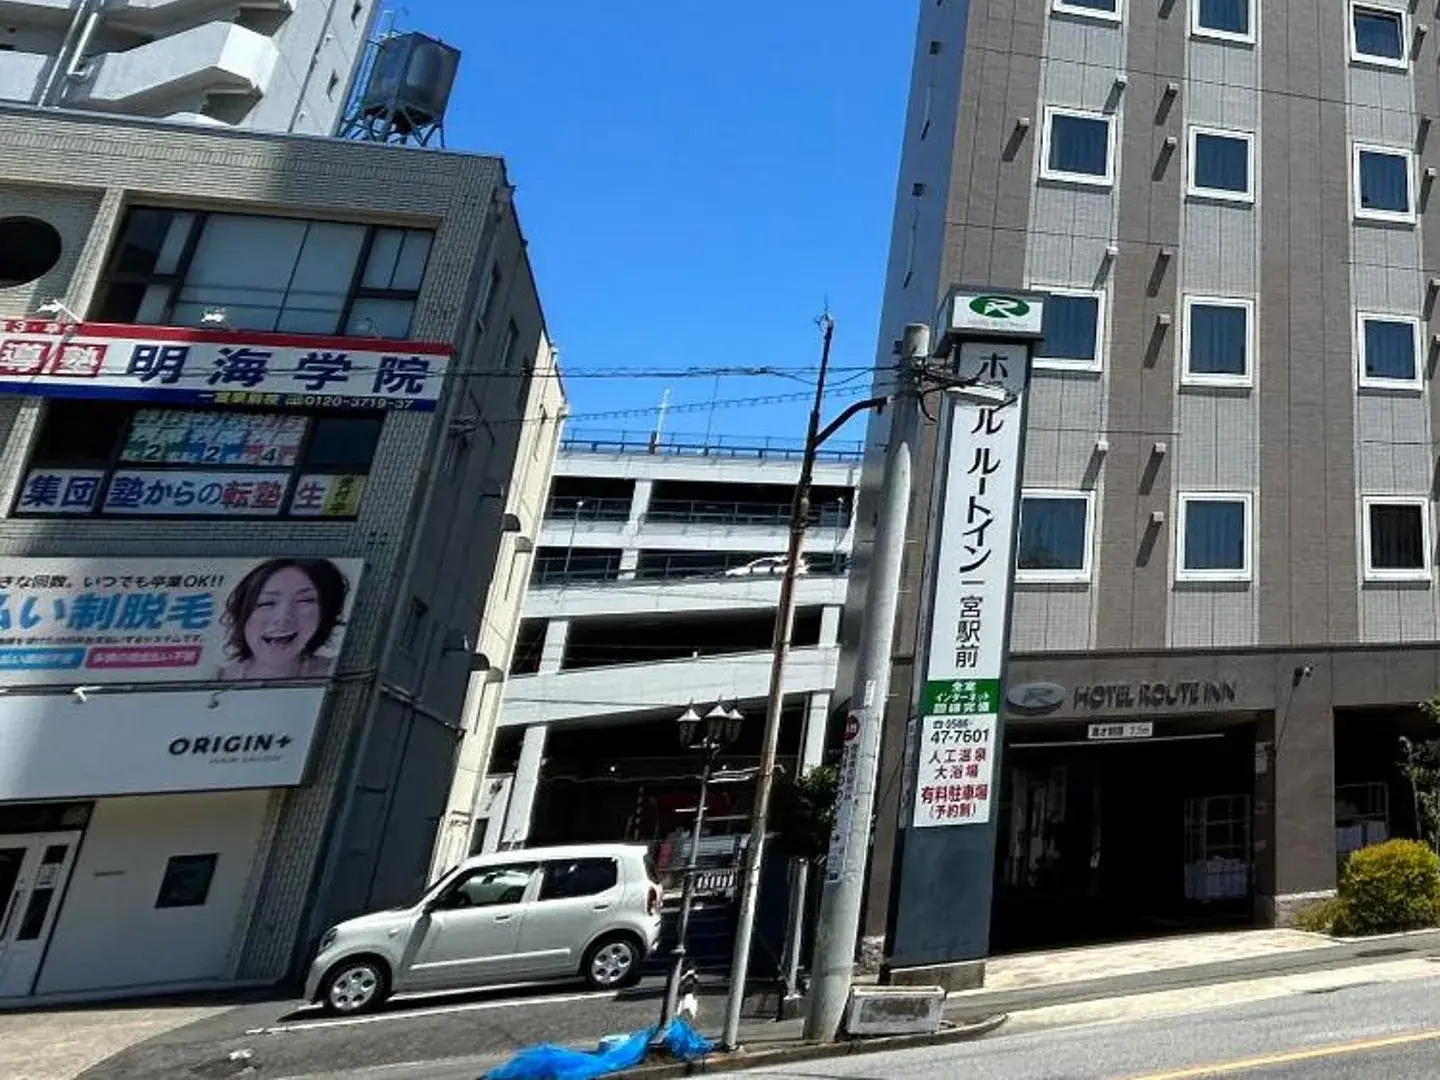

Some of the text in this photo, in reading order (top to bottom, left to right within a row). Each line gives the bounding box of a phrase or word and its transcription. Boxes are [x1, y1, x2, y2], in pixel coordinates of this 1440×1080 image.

[131, 345, 430, 394] 明海学院
[1073, 686, 1135, 710] HOTEL
[1139, 683, 1199, 708] ROUTE
[1203, 681, 1237, 705] INN
[168, 735, 293, 755] ORIGIN+
[931, 728, 989, 743] 47-7601
[921, 784, 989, 804] 有料駐車場
